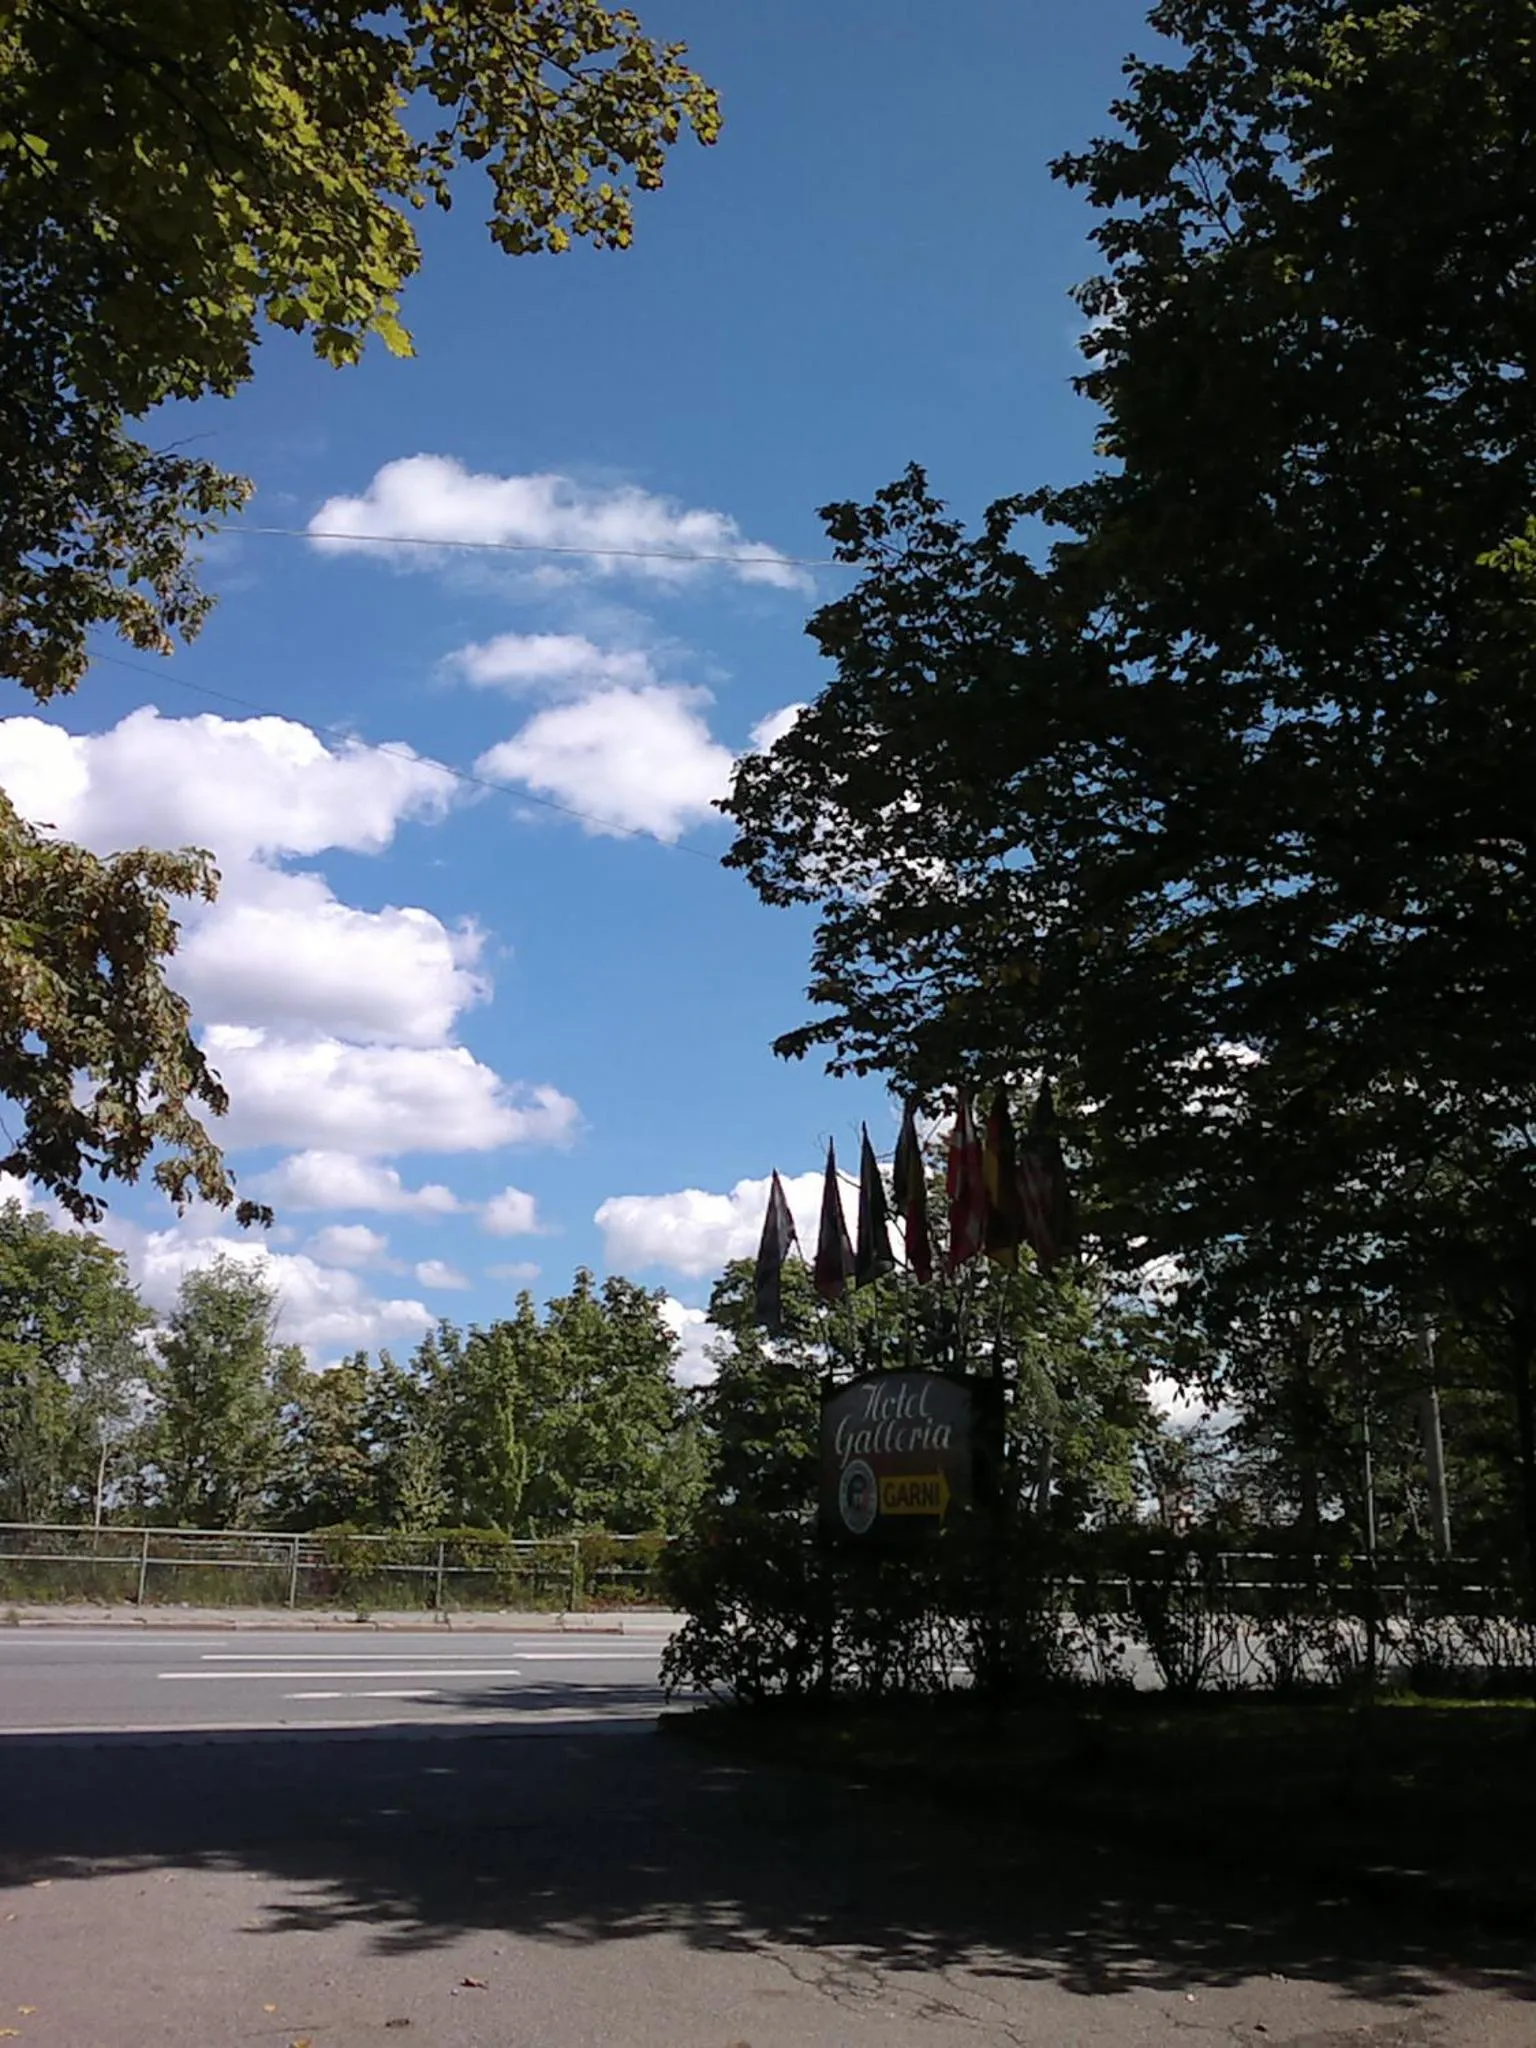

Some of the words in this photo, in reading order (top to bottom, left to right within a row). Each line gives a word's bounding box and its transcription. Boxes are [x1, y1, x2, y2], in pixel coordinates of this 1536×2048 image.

[861, 1381, 933, 1422] Hotel
[834, 1414, 951, 1470] Galleria
[884, 1482, 940, 1508] GARNI
